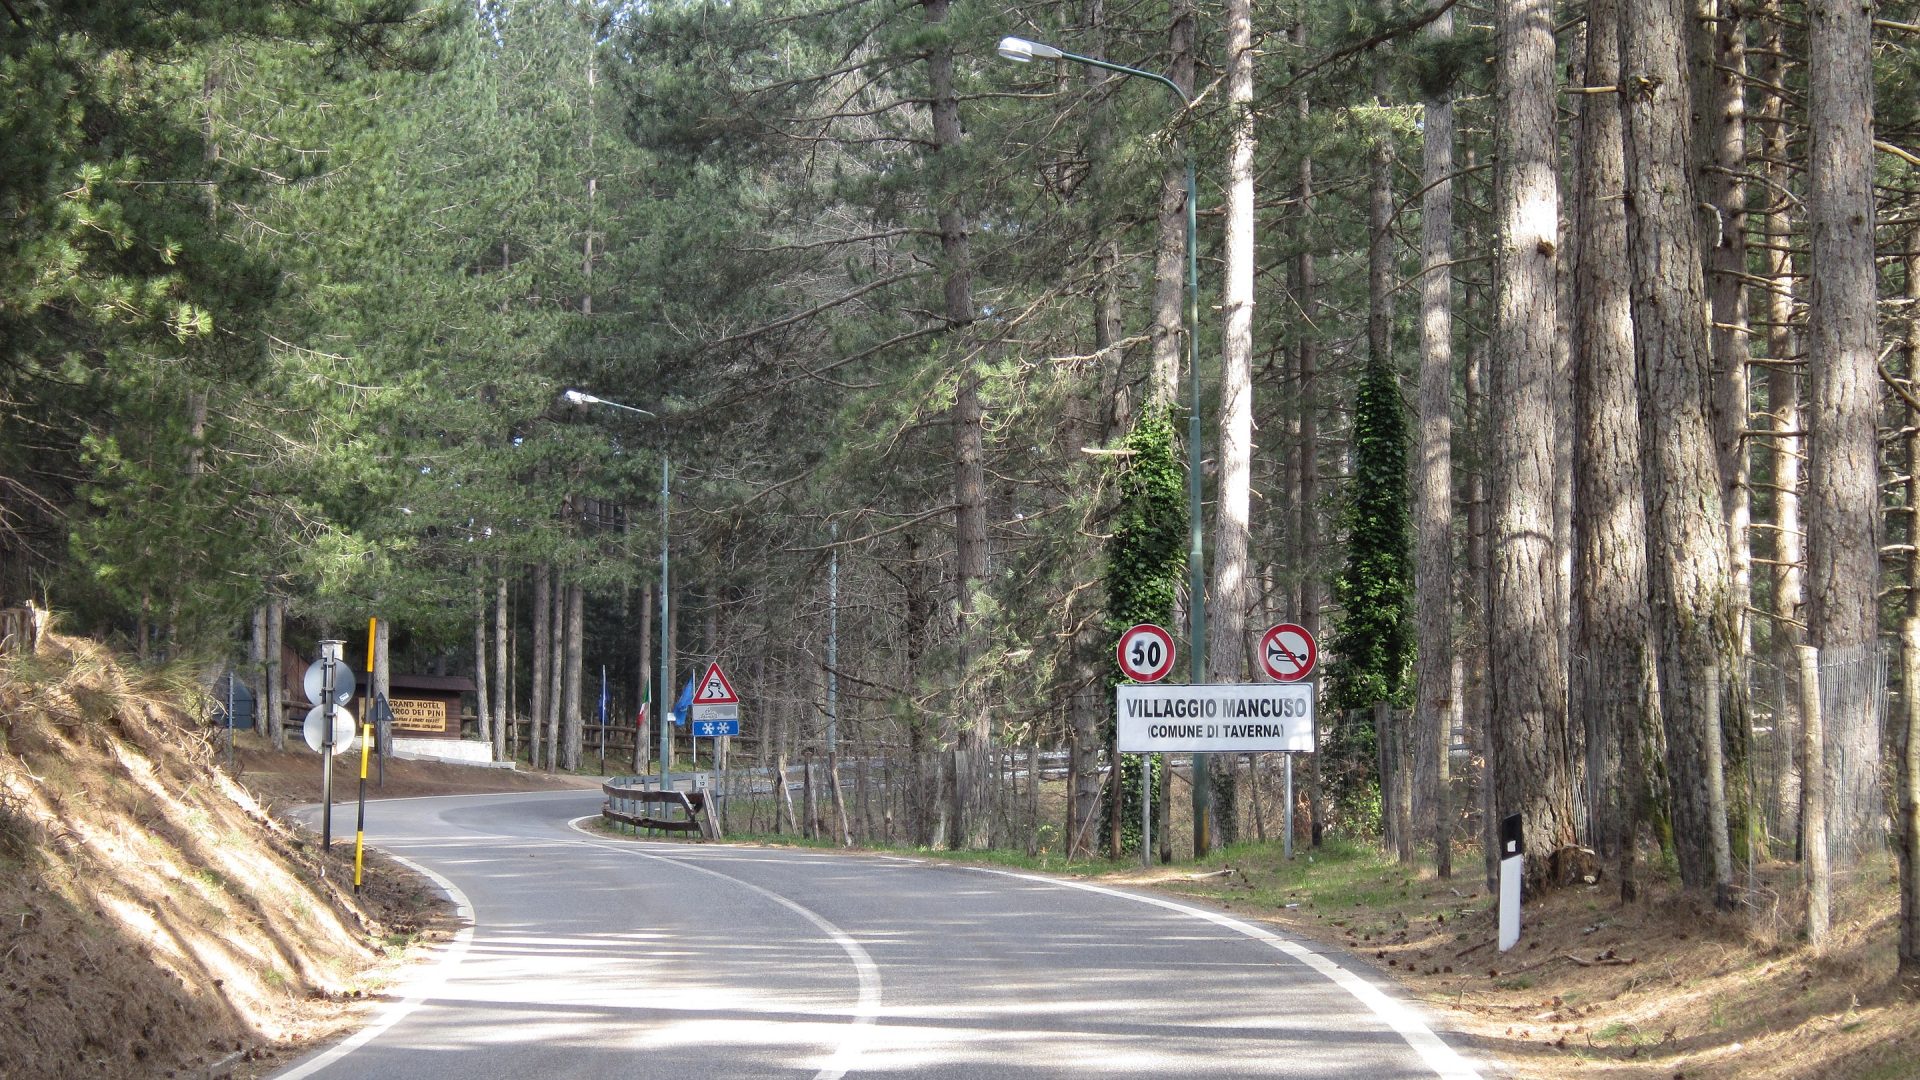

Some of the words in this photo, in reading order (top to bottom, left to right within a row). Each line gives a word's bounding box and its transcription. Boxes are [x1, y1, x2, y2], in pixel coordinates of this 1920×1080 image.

[1132, 639, 1161, 667] 50
[1126, 698, 1217, 718] VILLAGGIO
[1223, 698, 1307, 718] MANCUSO
[1148, 724, 1203, 738] (COMUNE
[1207, 724, 1219, 738] DI
[1224, 724, 1284, 738] TAVERNA)
